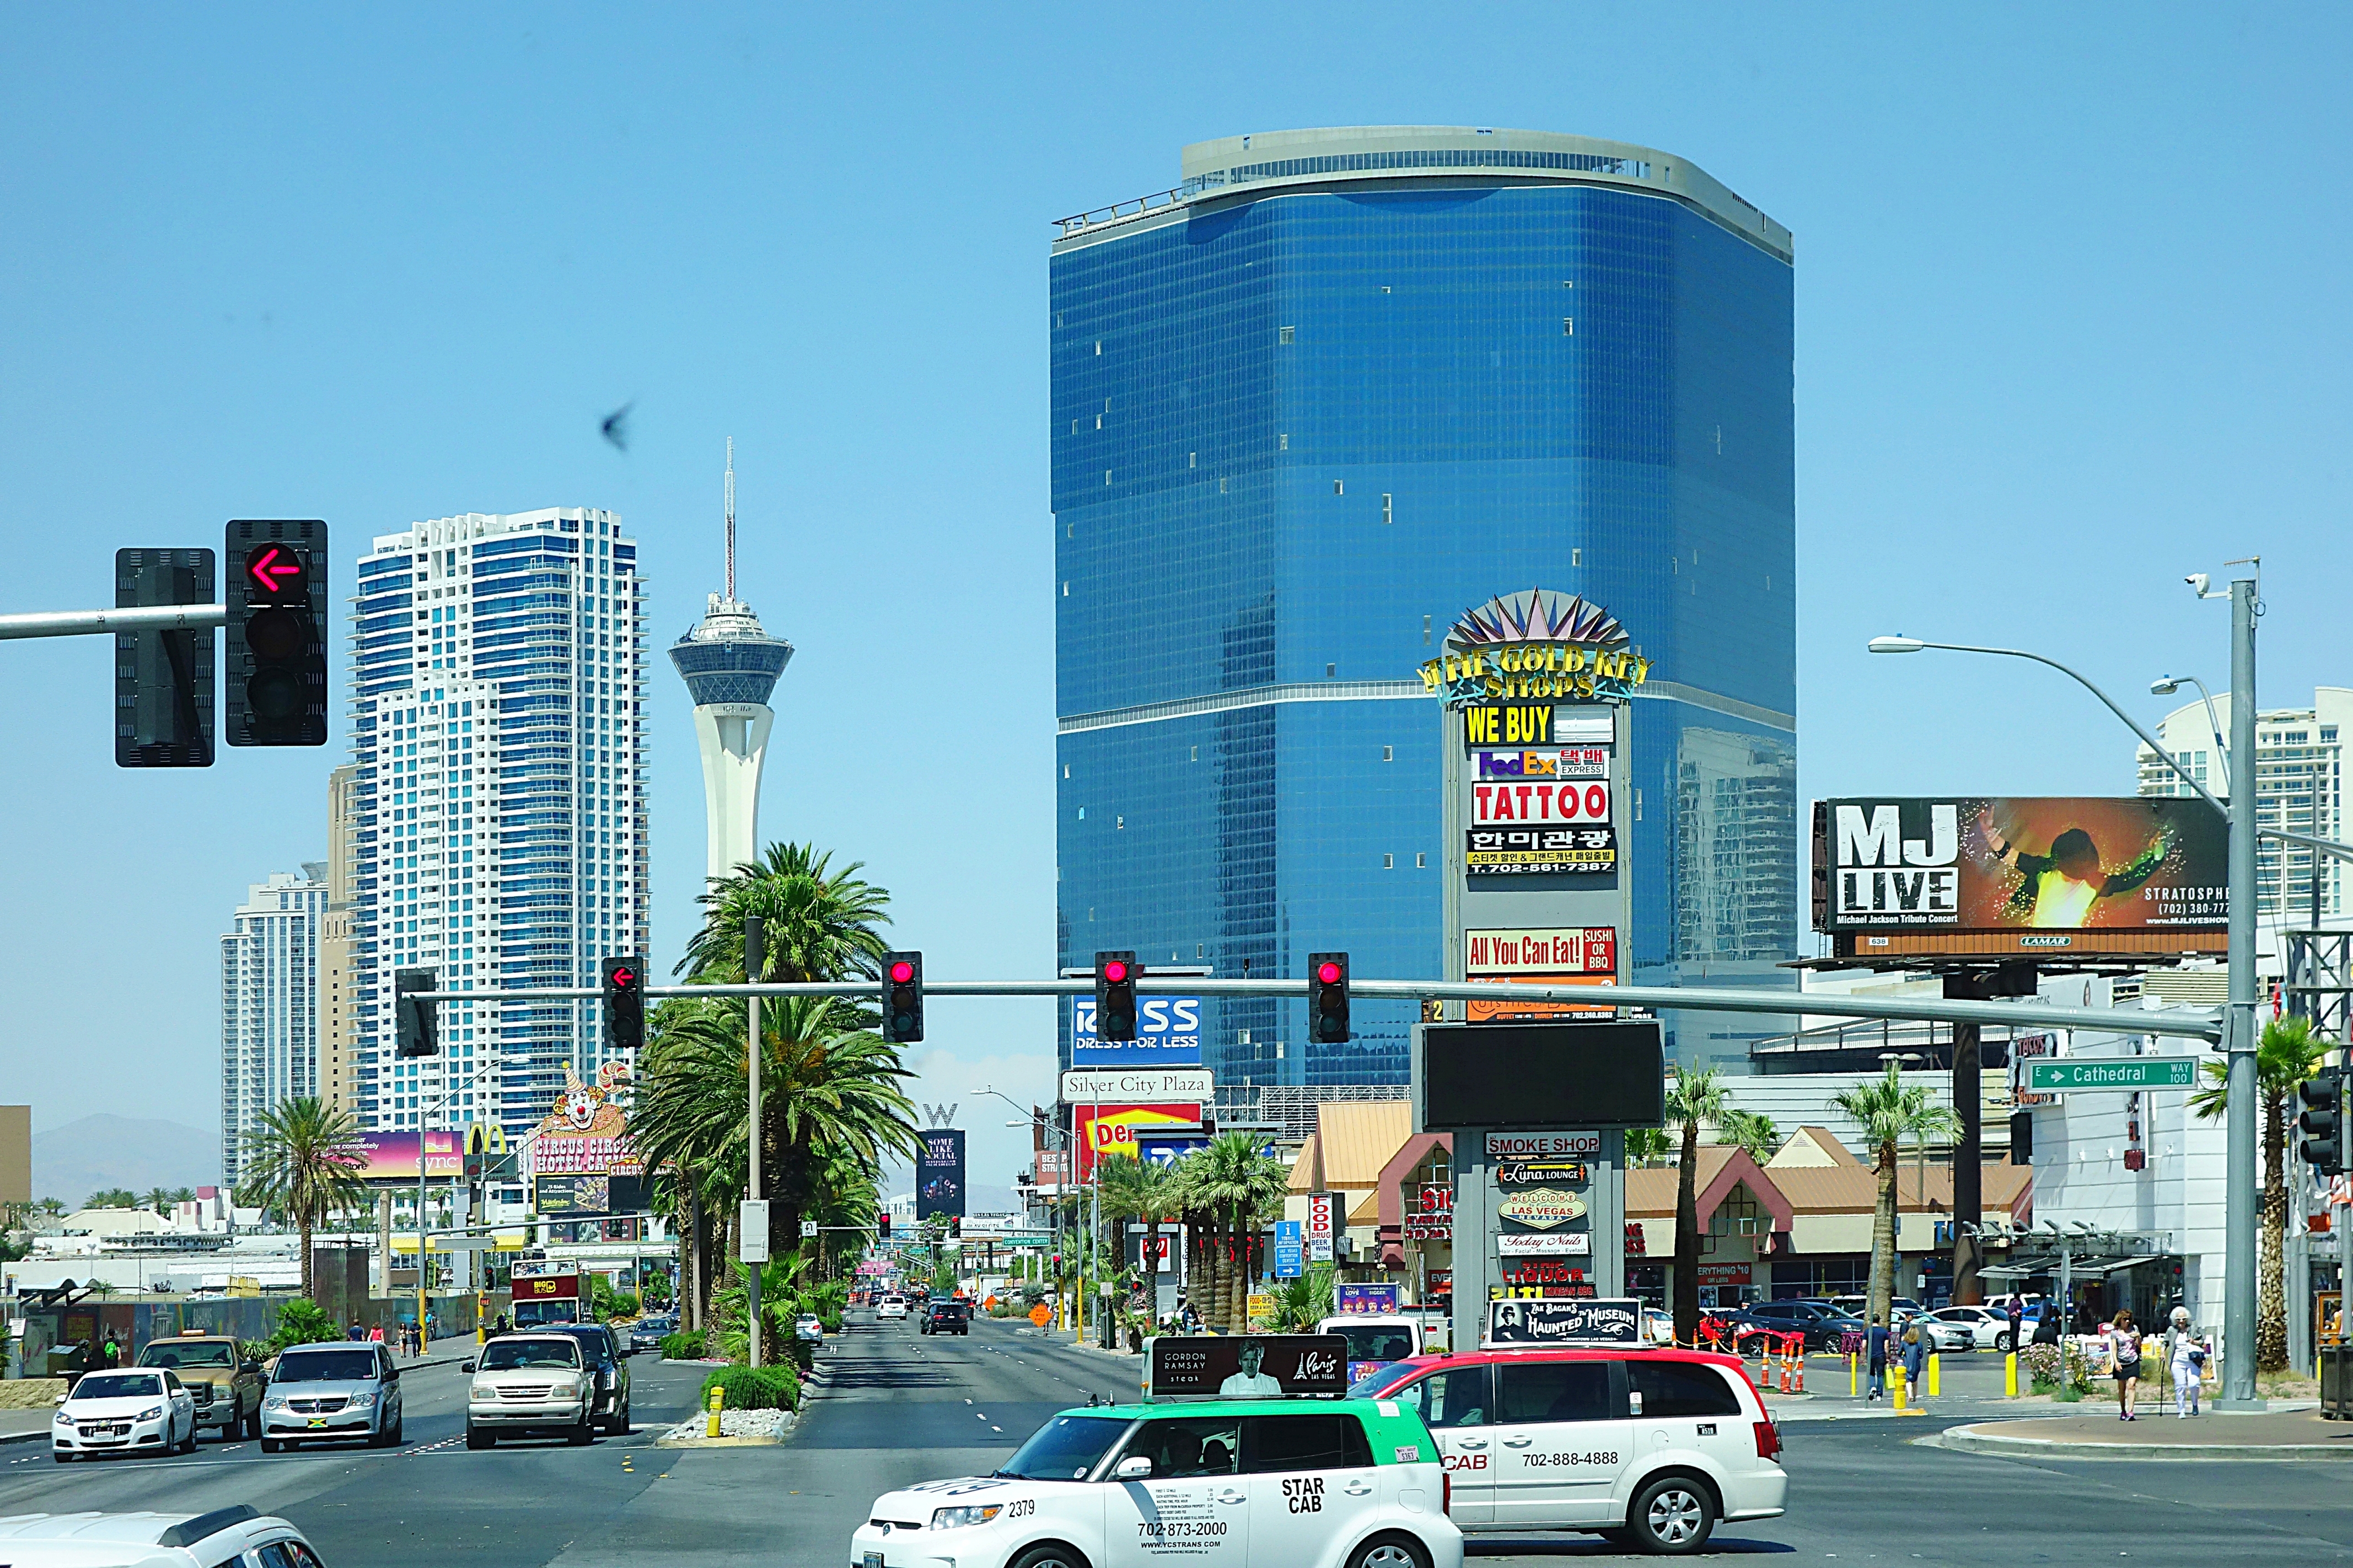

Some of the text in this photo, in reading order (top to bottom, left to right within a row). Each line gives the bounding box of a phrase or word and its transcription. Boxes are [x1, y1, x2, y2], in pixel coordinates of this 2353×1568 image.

[1422, 644, 1654, 686] THE GOLD KEY
[1485, 676, 1594, 698] SHOPS
[1467, 706, 1550, 743] WE BUY
[1479, 751, 1601, 776] FedEx EXPRESS
[1476, 785, 1606, 820] TATTOO
[1471, 830, 1611, 850] 한미관광
[1836, 805, 1958, 866] MJ
[1472, 854, 1498, 863] 쇼티켓
[1501, 853, 1519, 862] 할인
[1521, 854, 1527, 862] &
[1576, 852, 1610, 861] 매일출발
[1471, 863, 1611, 873] T. 702-561-7387
[1844, 872, 1954, 912] LIVE
[2159, 903, 2187, 915] (702)
[1837, 914, 1958, 924] Michael Jackson Tribute Concert
[1584, 930, 1613, 943] SUSHI
[1470, 935, 1580, 966] All You Can Eat!
[1592, 943, 1605, 955] OR
[1589, 956, 1609, 969] BBQ
[1077, 1000, 1199, 1033] RSS
[1129, 1037, 1157, 1048] FOR
[1163, 1036, 1199, 1048] LESS
[2018, 1034, 2045, 1057] TACOS
[2036, 1063, 2189, 1082] E Cathedral WAY
[2170, 1074, 2187, 1084] 100
[1069, 1075, 1205, 1096] Silver City Plaza
[922, 1102, 958, 1129] W
[341, 1143, 379, 1152] completely
[536, 1139, 584, 1156] CIRCUS
[1489, 1138, 1598, 1153] SMOKE SHOP
[415, 1155, 458, 1175] sync
[536, 1156, 583, 1172] HOTEL
[610, 1166, 643, 1176] CIRCUS
[1503, 1164, 1578, 1183] Luna LOUNGE
[1312, 1195, 1329, 1232] FOOD
[1505, 1234, 1581, 1248] Today Nails
[1502, 1268, 1584, 1283] LIQUOR
[1738, 1264, 1749, 1274] $10
[1545, 1286, 1593, 1296] KOREAN BBQ
[1531, 1303, 1544, 1314] ZAK
[1525, 1308, 1635, 1338] HAUNTED MUSEUM
[1307, 1351, 1337, 1375] Paris
[1401, 1452, 1415, 1461] S363
[1444, 1455, 1487, 1471] CAB
[1522, 1451, 1619, 1467] 702-888-4888
[1282, 1478, 1325, 1496] STAR
[1009, 1500, 1035, 1517] 2379
[1289, 1496, 1321, 1514] CAB
